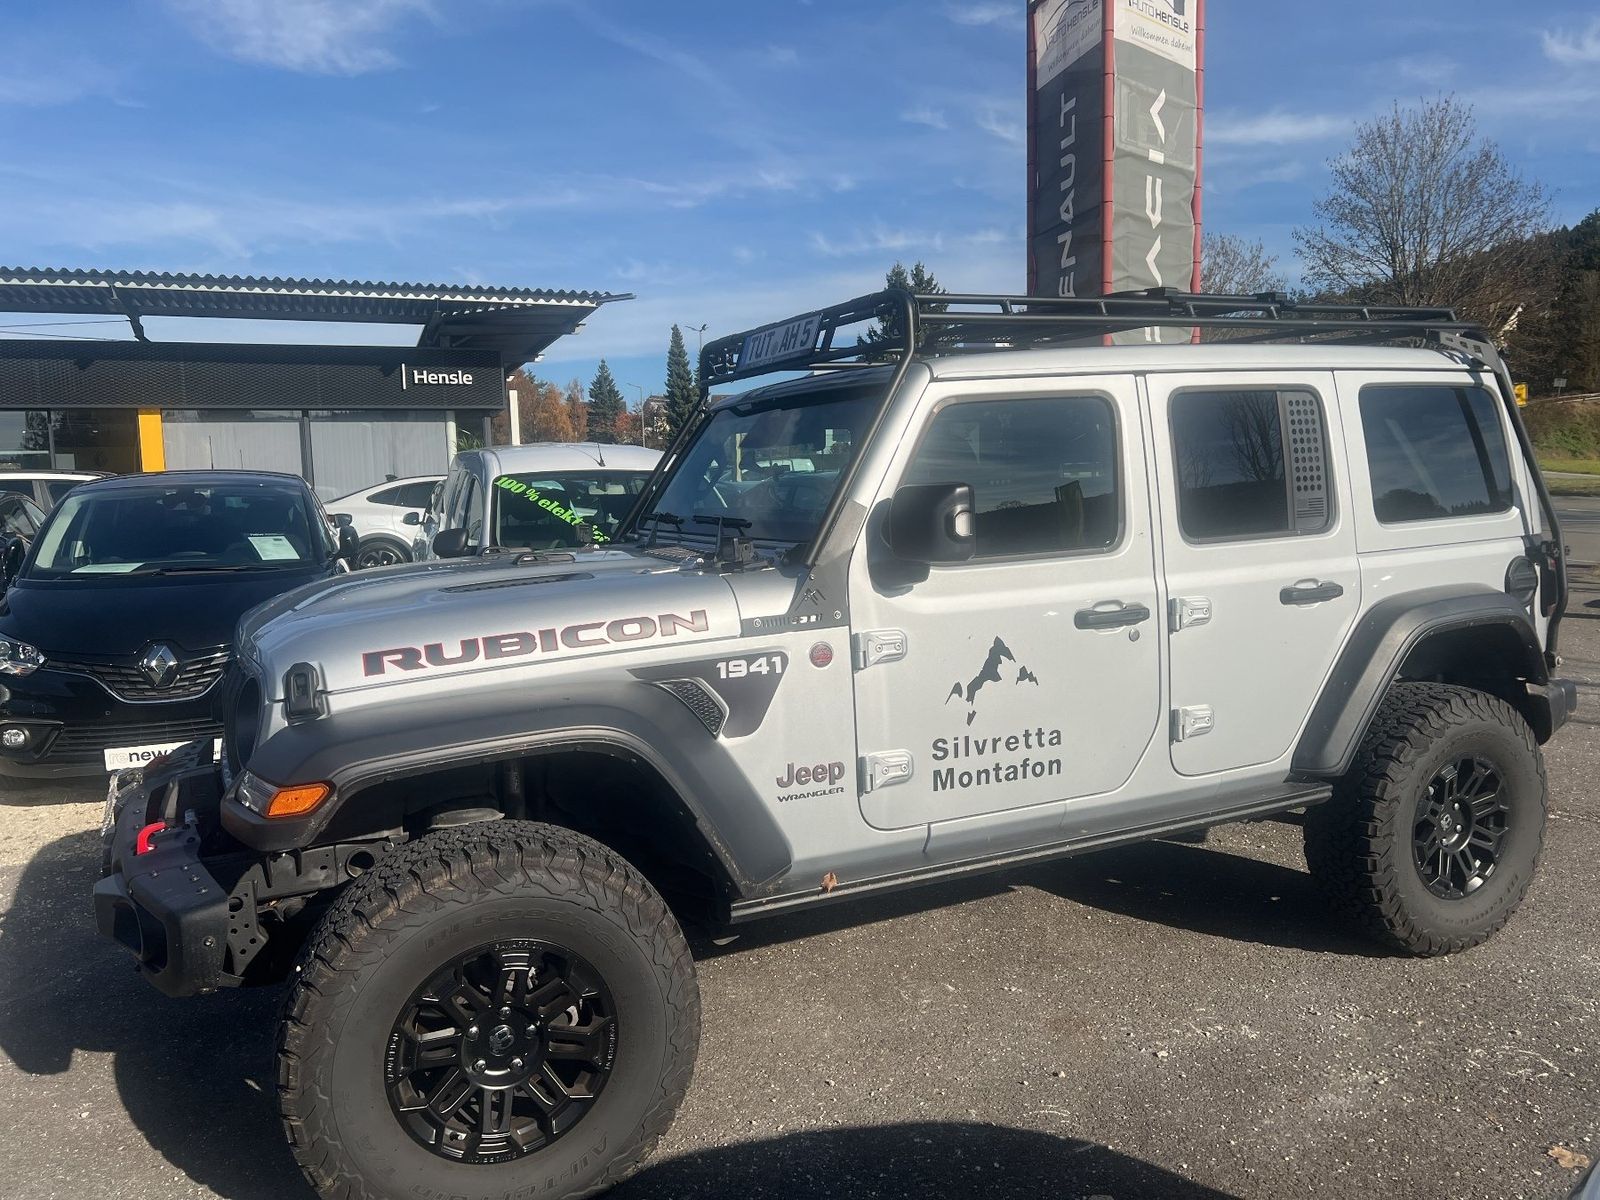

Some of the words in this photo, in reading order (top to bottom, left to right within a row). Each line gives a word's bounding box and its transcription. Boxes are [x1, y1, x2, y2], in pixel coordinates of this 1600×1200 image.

[1057, 92, 1077, 297] ENAULT
[750, 331, 775, 360] TUT
[413, 370, 473, 385] Hensle
[494, 477, 527, 494] 100
[524, 488, 541, 502] %
[362, 609, 709, 677] RUBICON
[716, 656, 782, 679] 1941
[932, 728, 1062, 761] Silvretta
[776, 761, 846, 788] Jeep
[932, 758, 1062, 792] Montafon
[777, 786, 845, 803] WRANGLER
